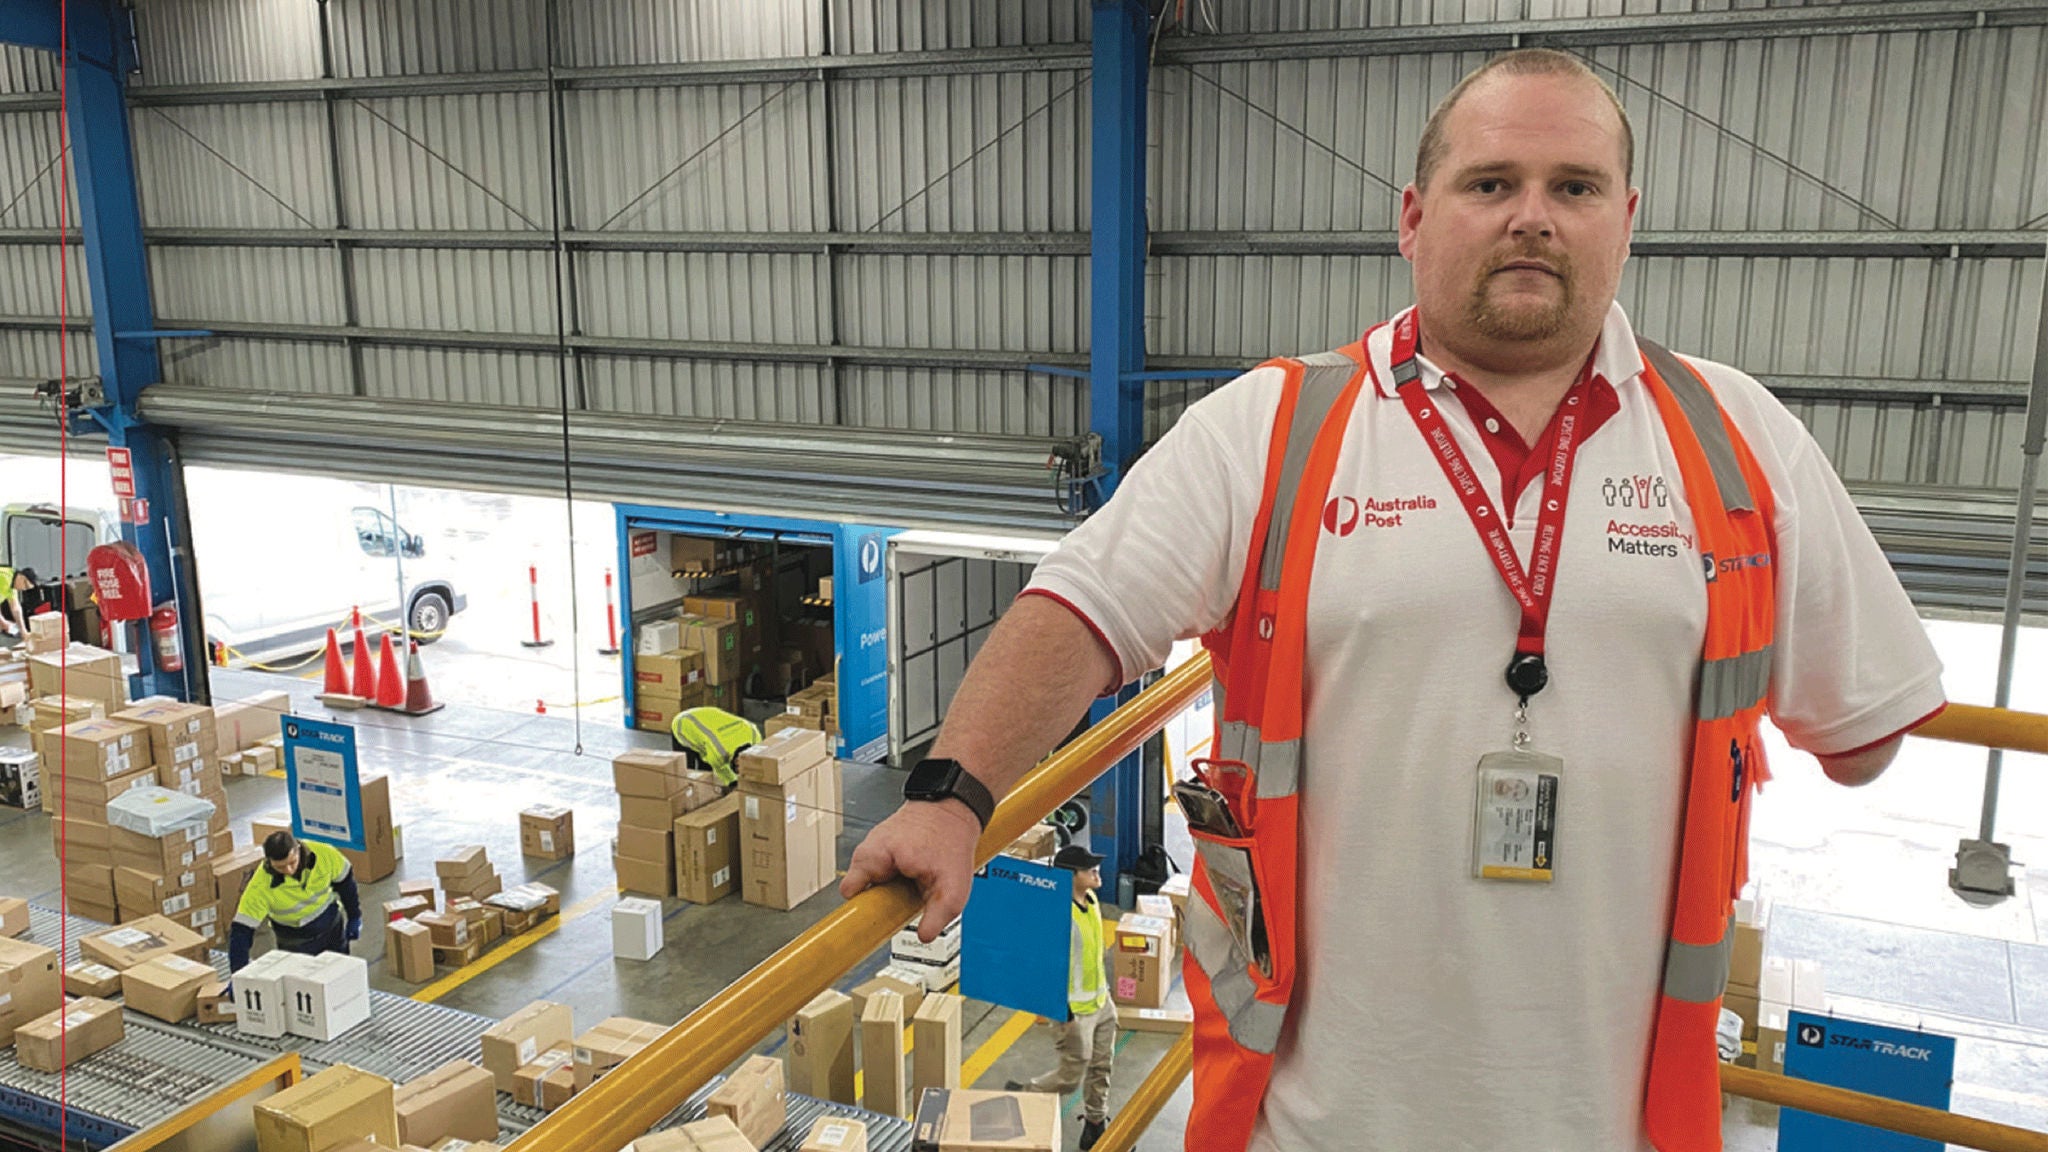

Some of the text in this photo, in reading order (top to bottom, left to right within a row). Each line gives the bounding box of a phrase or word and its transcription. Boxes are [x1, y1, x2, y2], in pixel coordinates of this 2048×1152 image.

[1365, 495, 1437, 512] Australia
[1365, 513, 1403, 527] Post
[1608, 538, 1678, 557] Matters
[992, 868, 1057, 891] STARTRACK
[1830, 1034, 1932, 1061] STARTRACK
